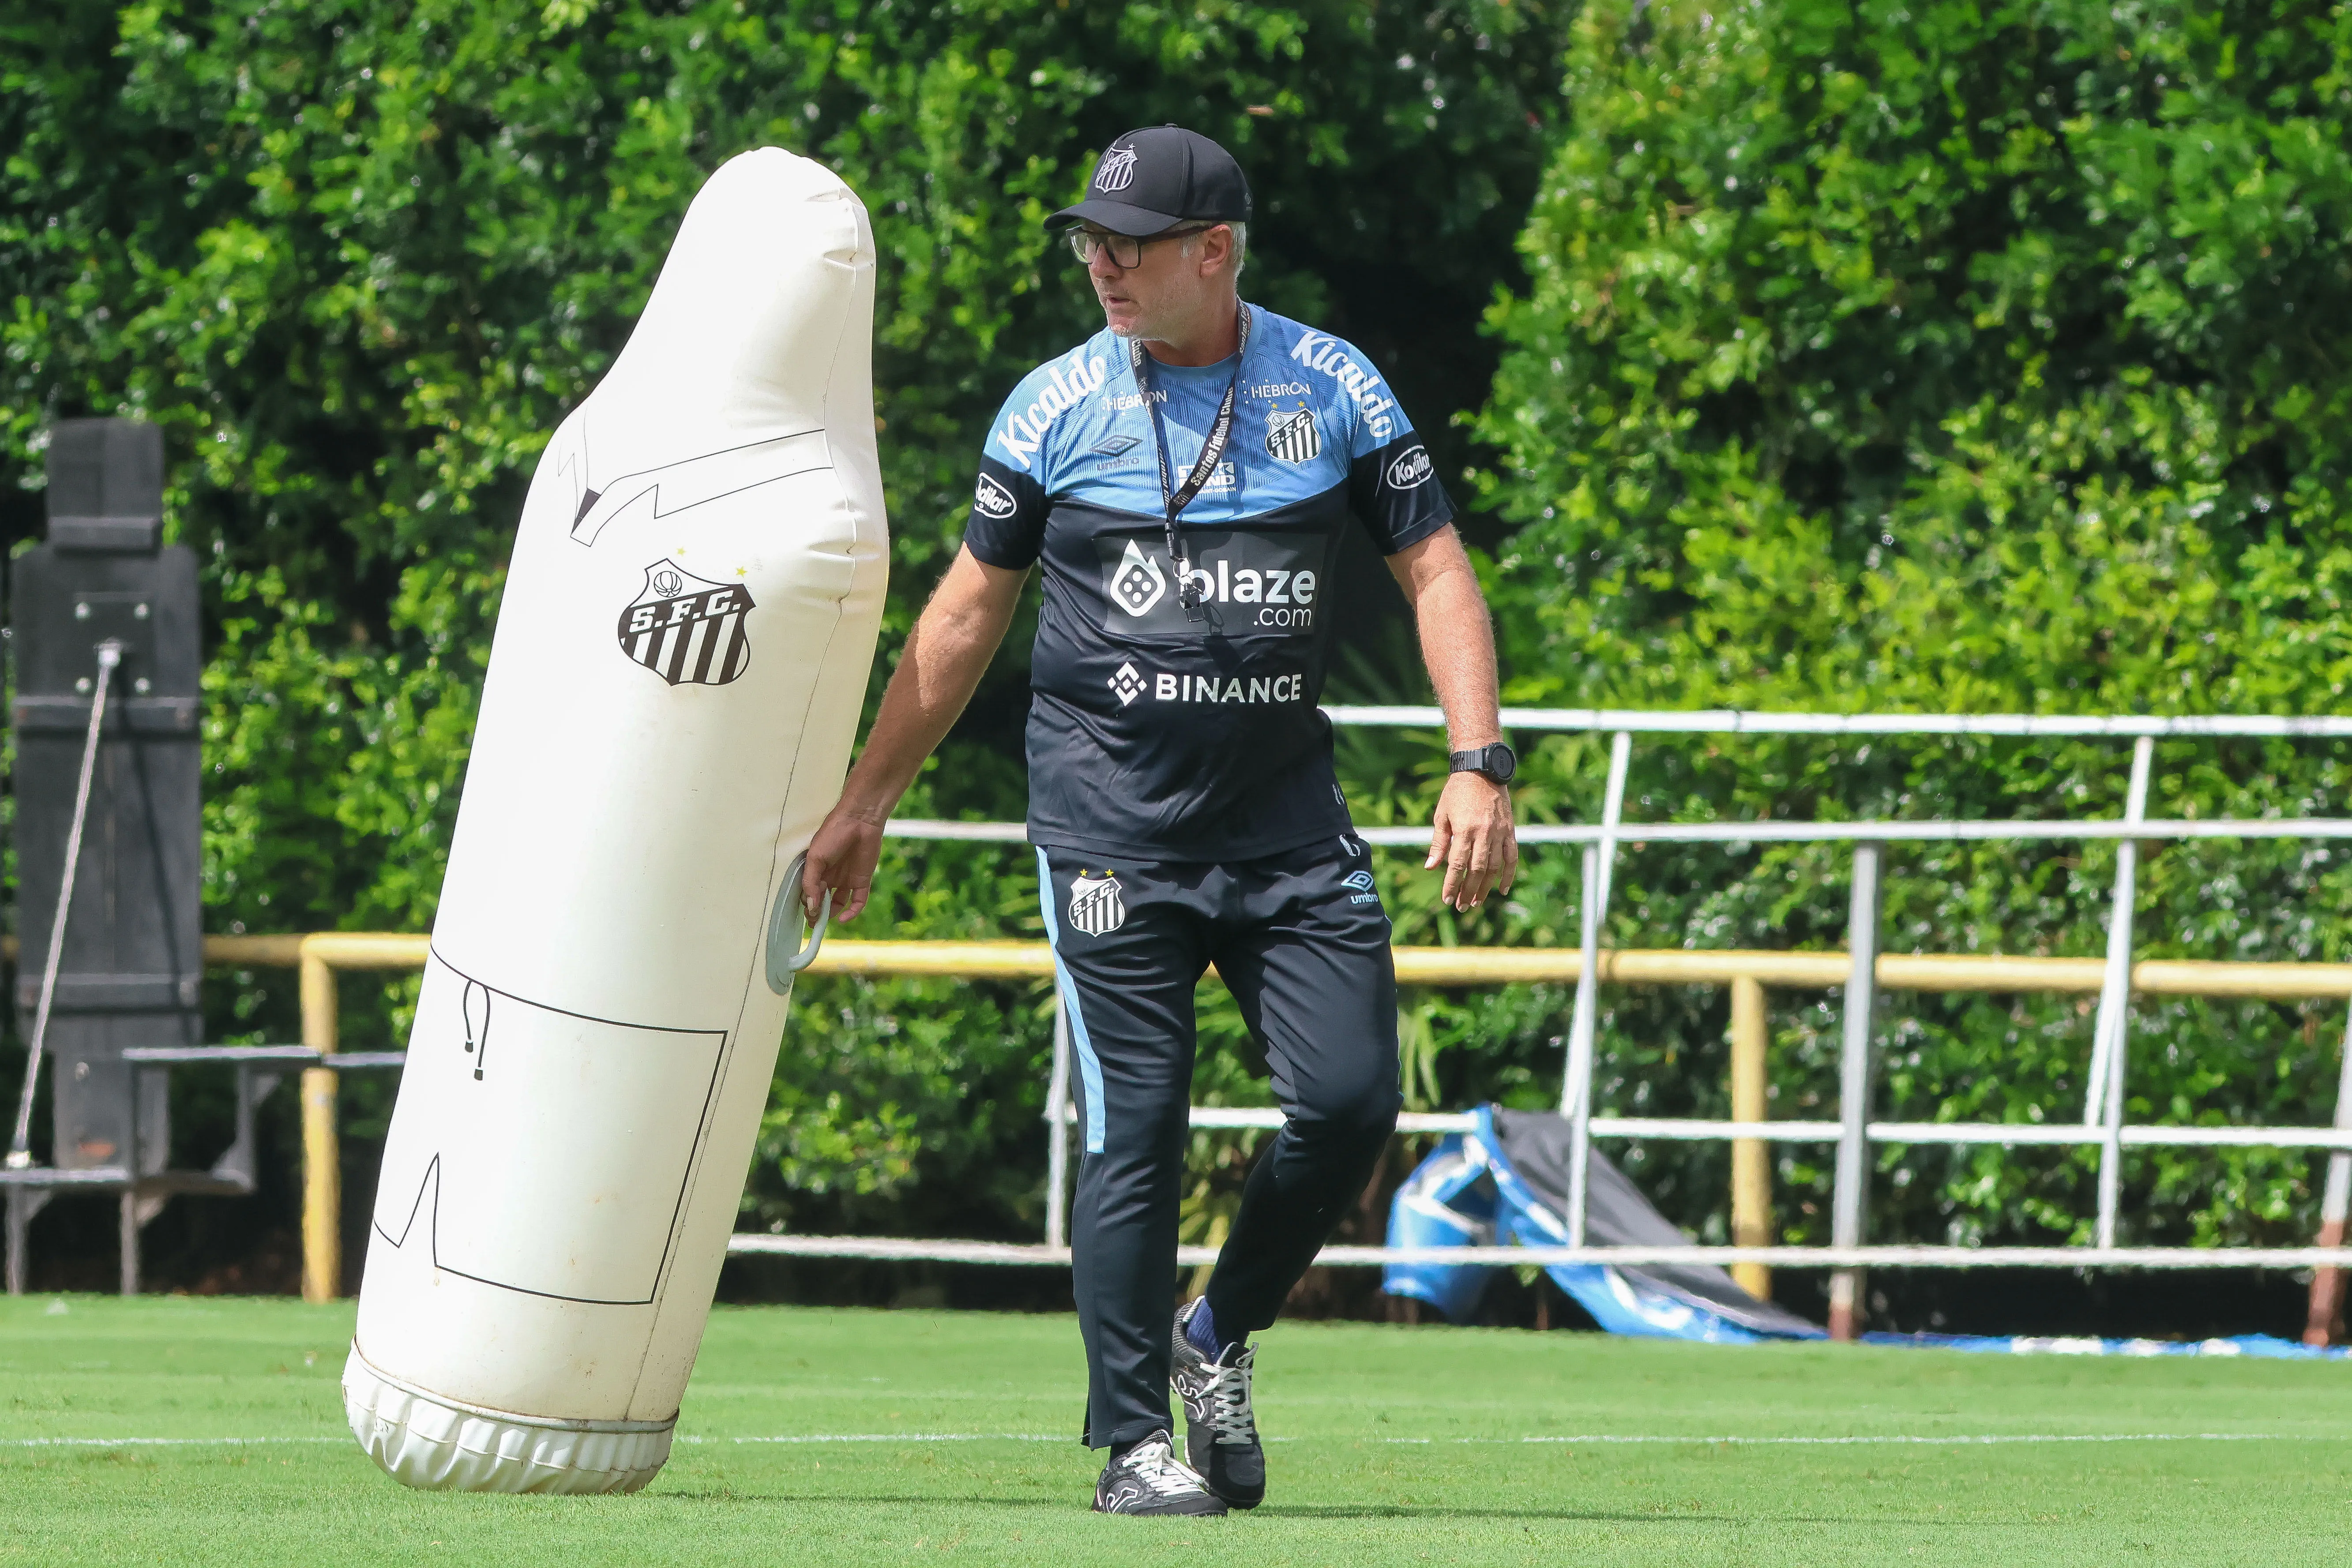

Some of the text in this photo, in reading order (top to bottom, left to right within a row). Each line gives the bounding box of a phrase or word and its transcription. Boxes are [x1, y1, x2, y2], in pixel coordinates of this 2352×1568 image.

[1251, 382, 1311, 398] HEBRON
[1290, 330, 1394, 438] Kicaldo
[996, 354, 1105, 469] Kicaldo
[1191, 386, 1233, 486] Santos Futebol Clube
[1270, 413, 1310, 447] S.F.C.
[1097, 458, 1139, 470] umbro
[629, 590, 741, 633] S.F.C.
[1254, 608, 1311, 627] .com
[1155, 673, 1302, 703] BINANCE
[1073, 882, 1114, 917] S.F.C.
[1350, 892, 1378, 904] umbro
